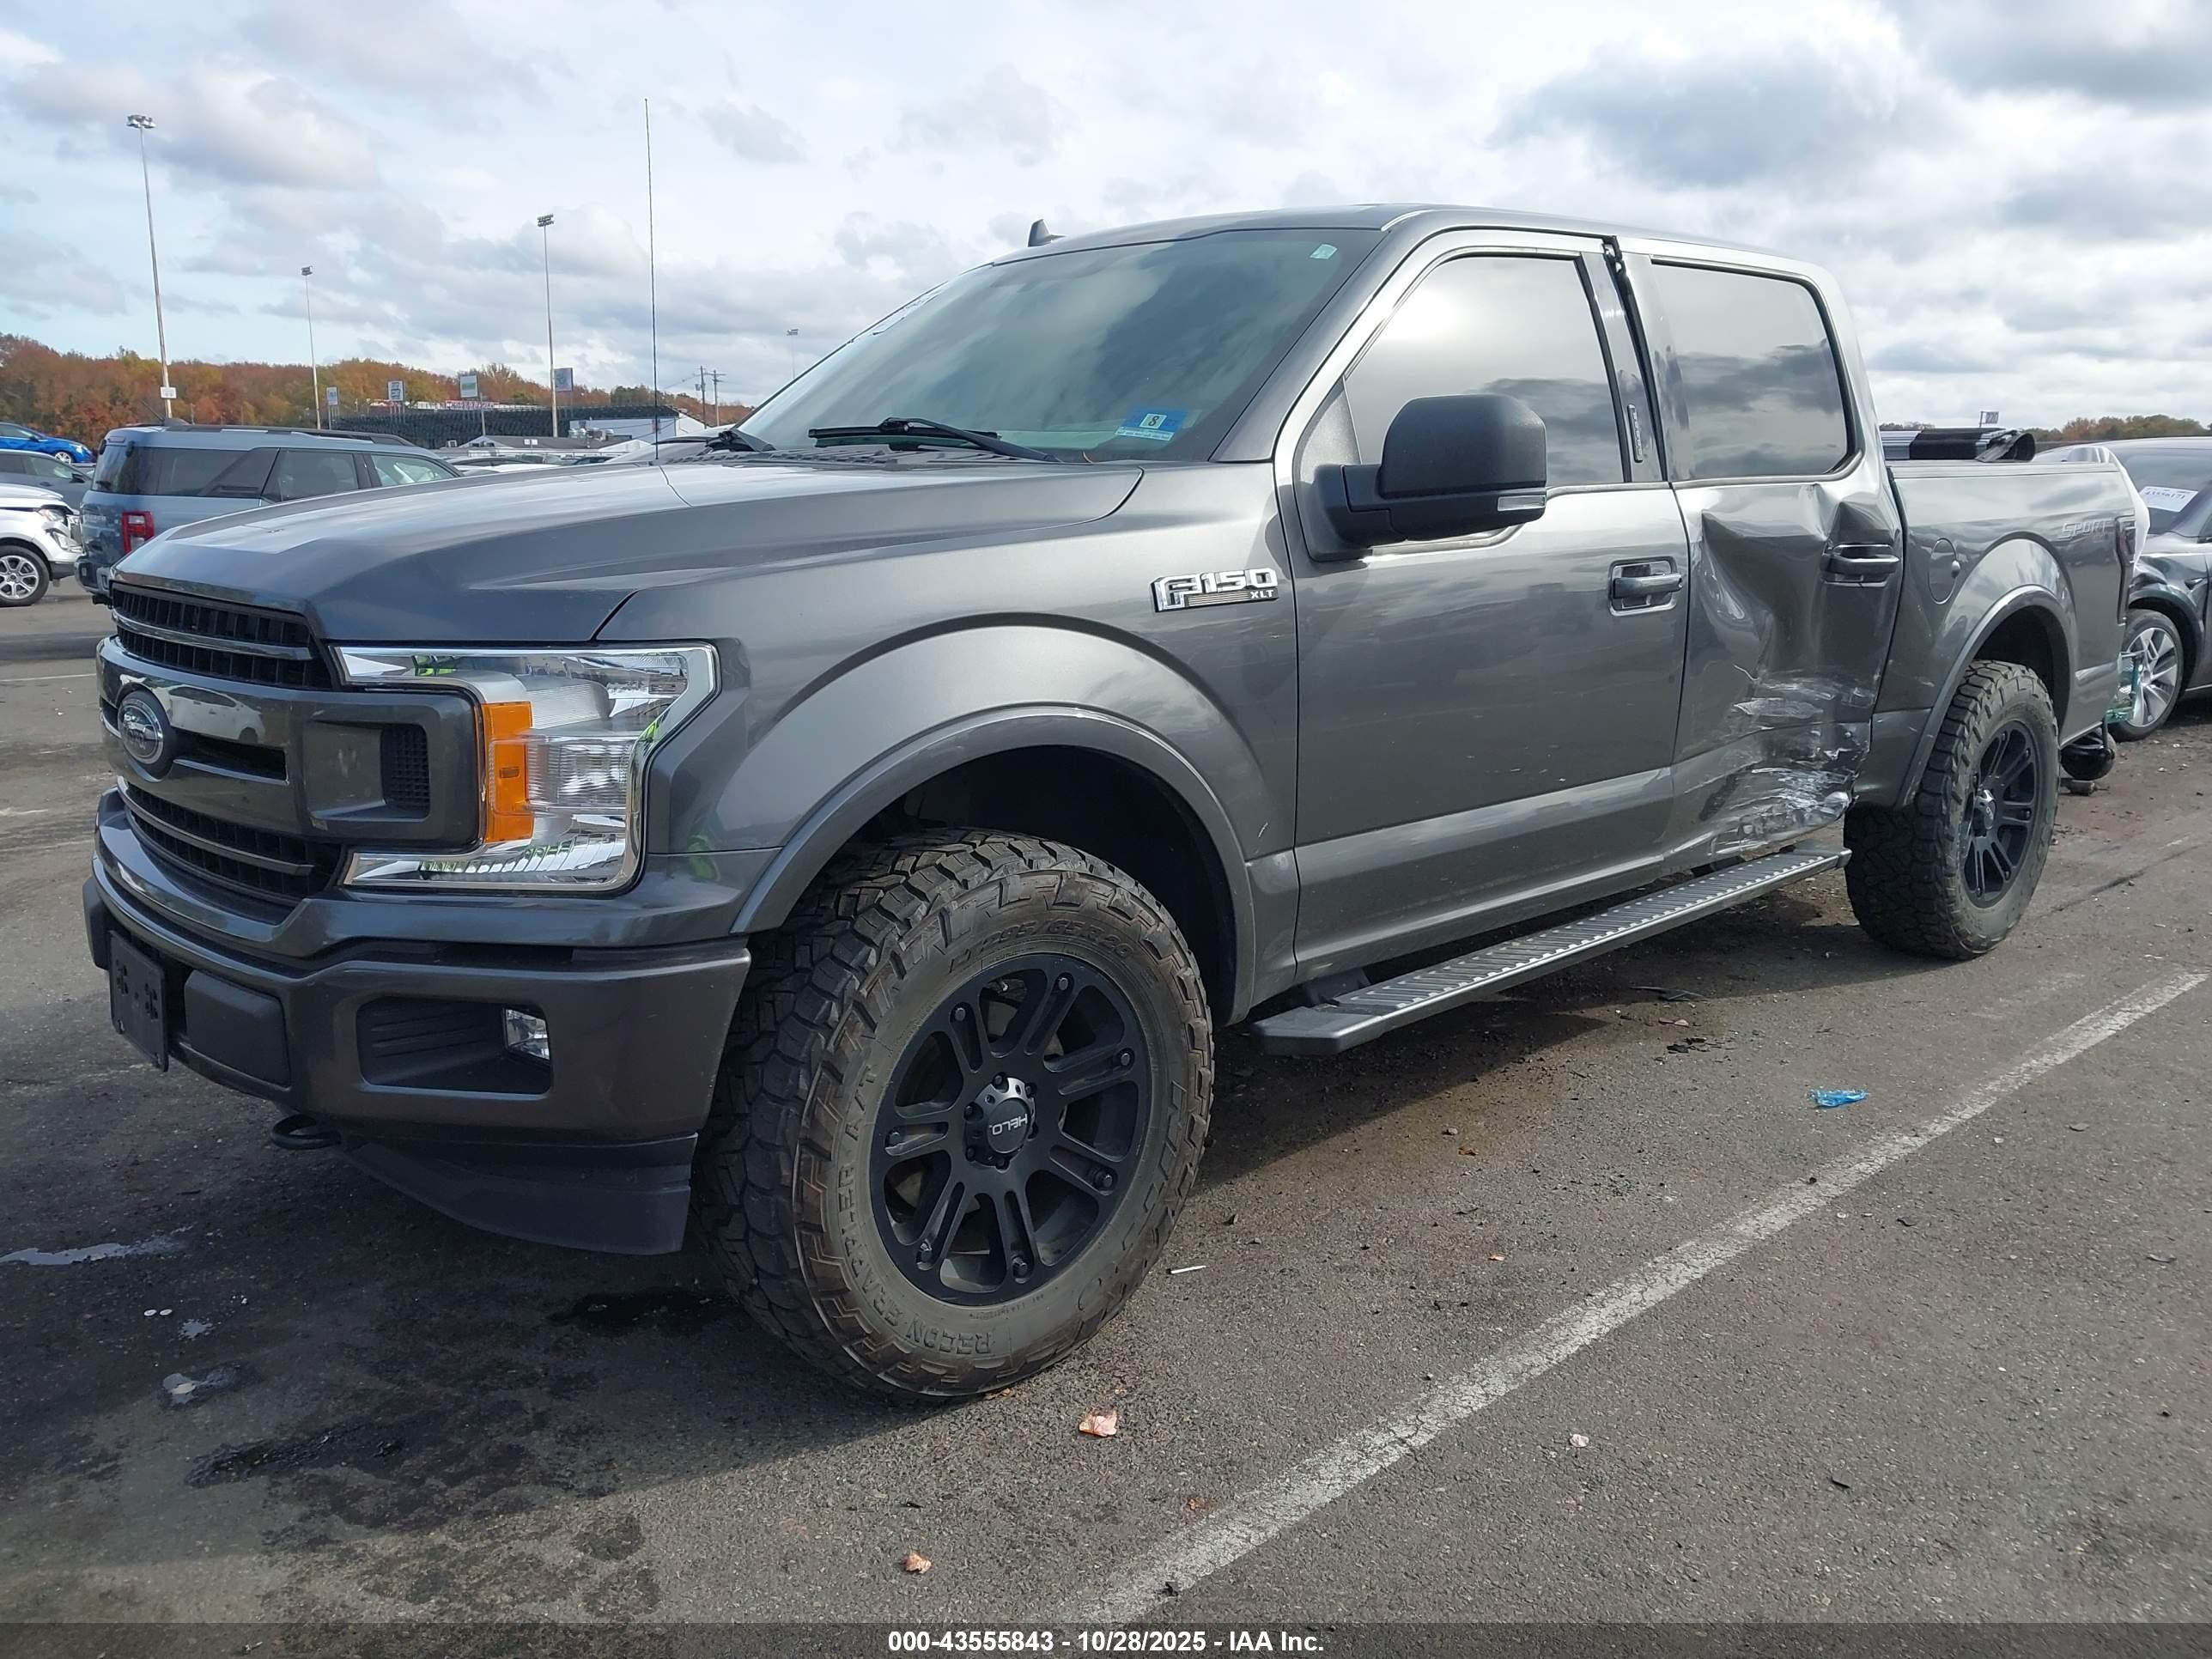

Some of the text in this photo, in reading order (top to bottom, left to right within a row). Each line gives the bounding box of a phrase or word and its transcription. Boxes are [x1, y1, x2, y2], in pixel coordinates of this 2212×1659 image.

[1148, 416, 1159, 427] 8
[2058, 520, 2112, 540] SPORT
[1250, 589, 1274, 599] XLT
[906, 1318, 993, 1356] RECON
